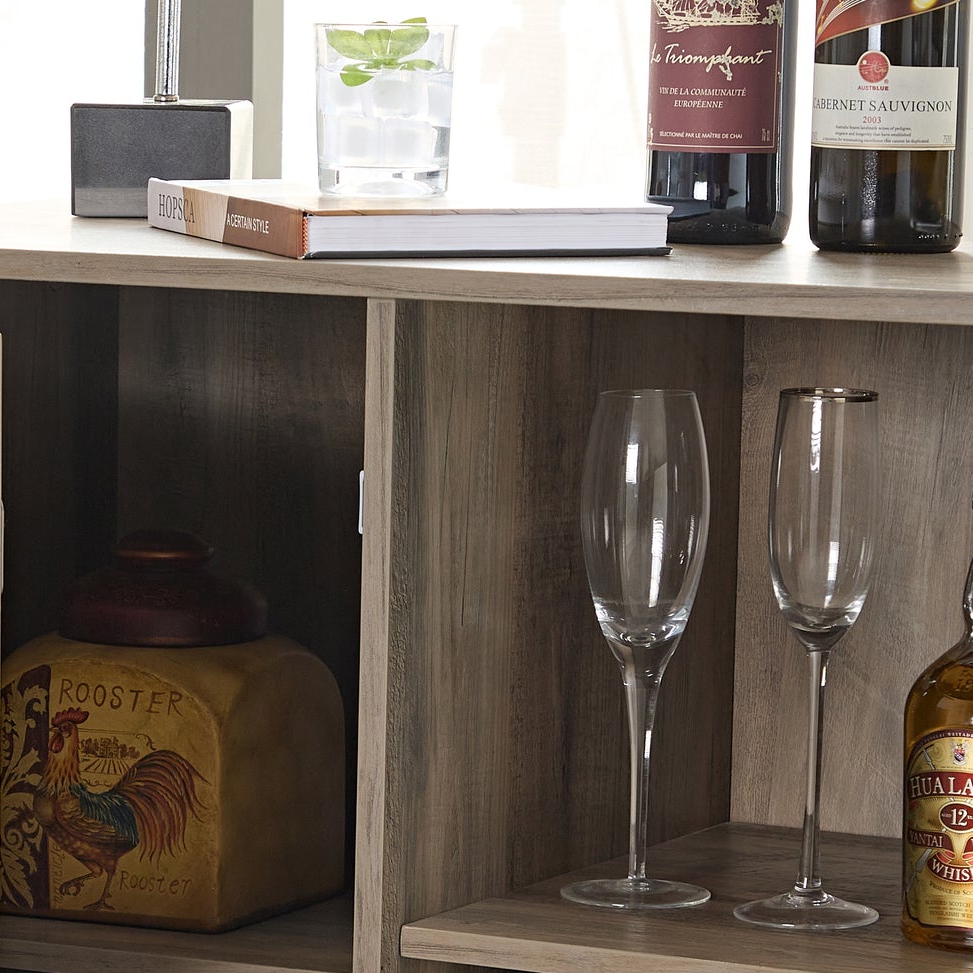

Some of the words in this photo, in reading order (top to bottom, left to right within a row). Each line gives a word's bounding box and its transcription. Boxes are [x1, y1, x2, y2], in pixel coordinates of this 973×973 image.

[651, 43, 662, 65] Le
[664, 43, 773, 81] Triomphant
[659, 86, 669, 95] VIN
[669, 87, 679, 95] DE
[690, 87, 747, 97] COMMUNAUTÉ
[674, 99, 724, 109] EUROPÉENNE
[812, 97, 867, 111] CABERNET
[869, 100, 953, 113] SAUVIGNON
[862, 115, 883, 124] 2003
[158, 194, 196, 224] HOPSCA
[230, 214, 253, 232] CERTAIN
[252, 218, 270, 234] STYLE
[58, 678, 185, 717] ROOSTER
[950, 808, 968, 826] 12
[119, 870, 193, 896] Rooster
